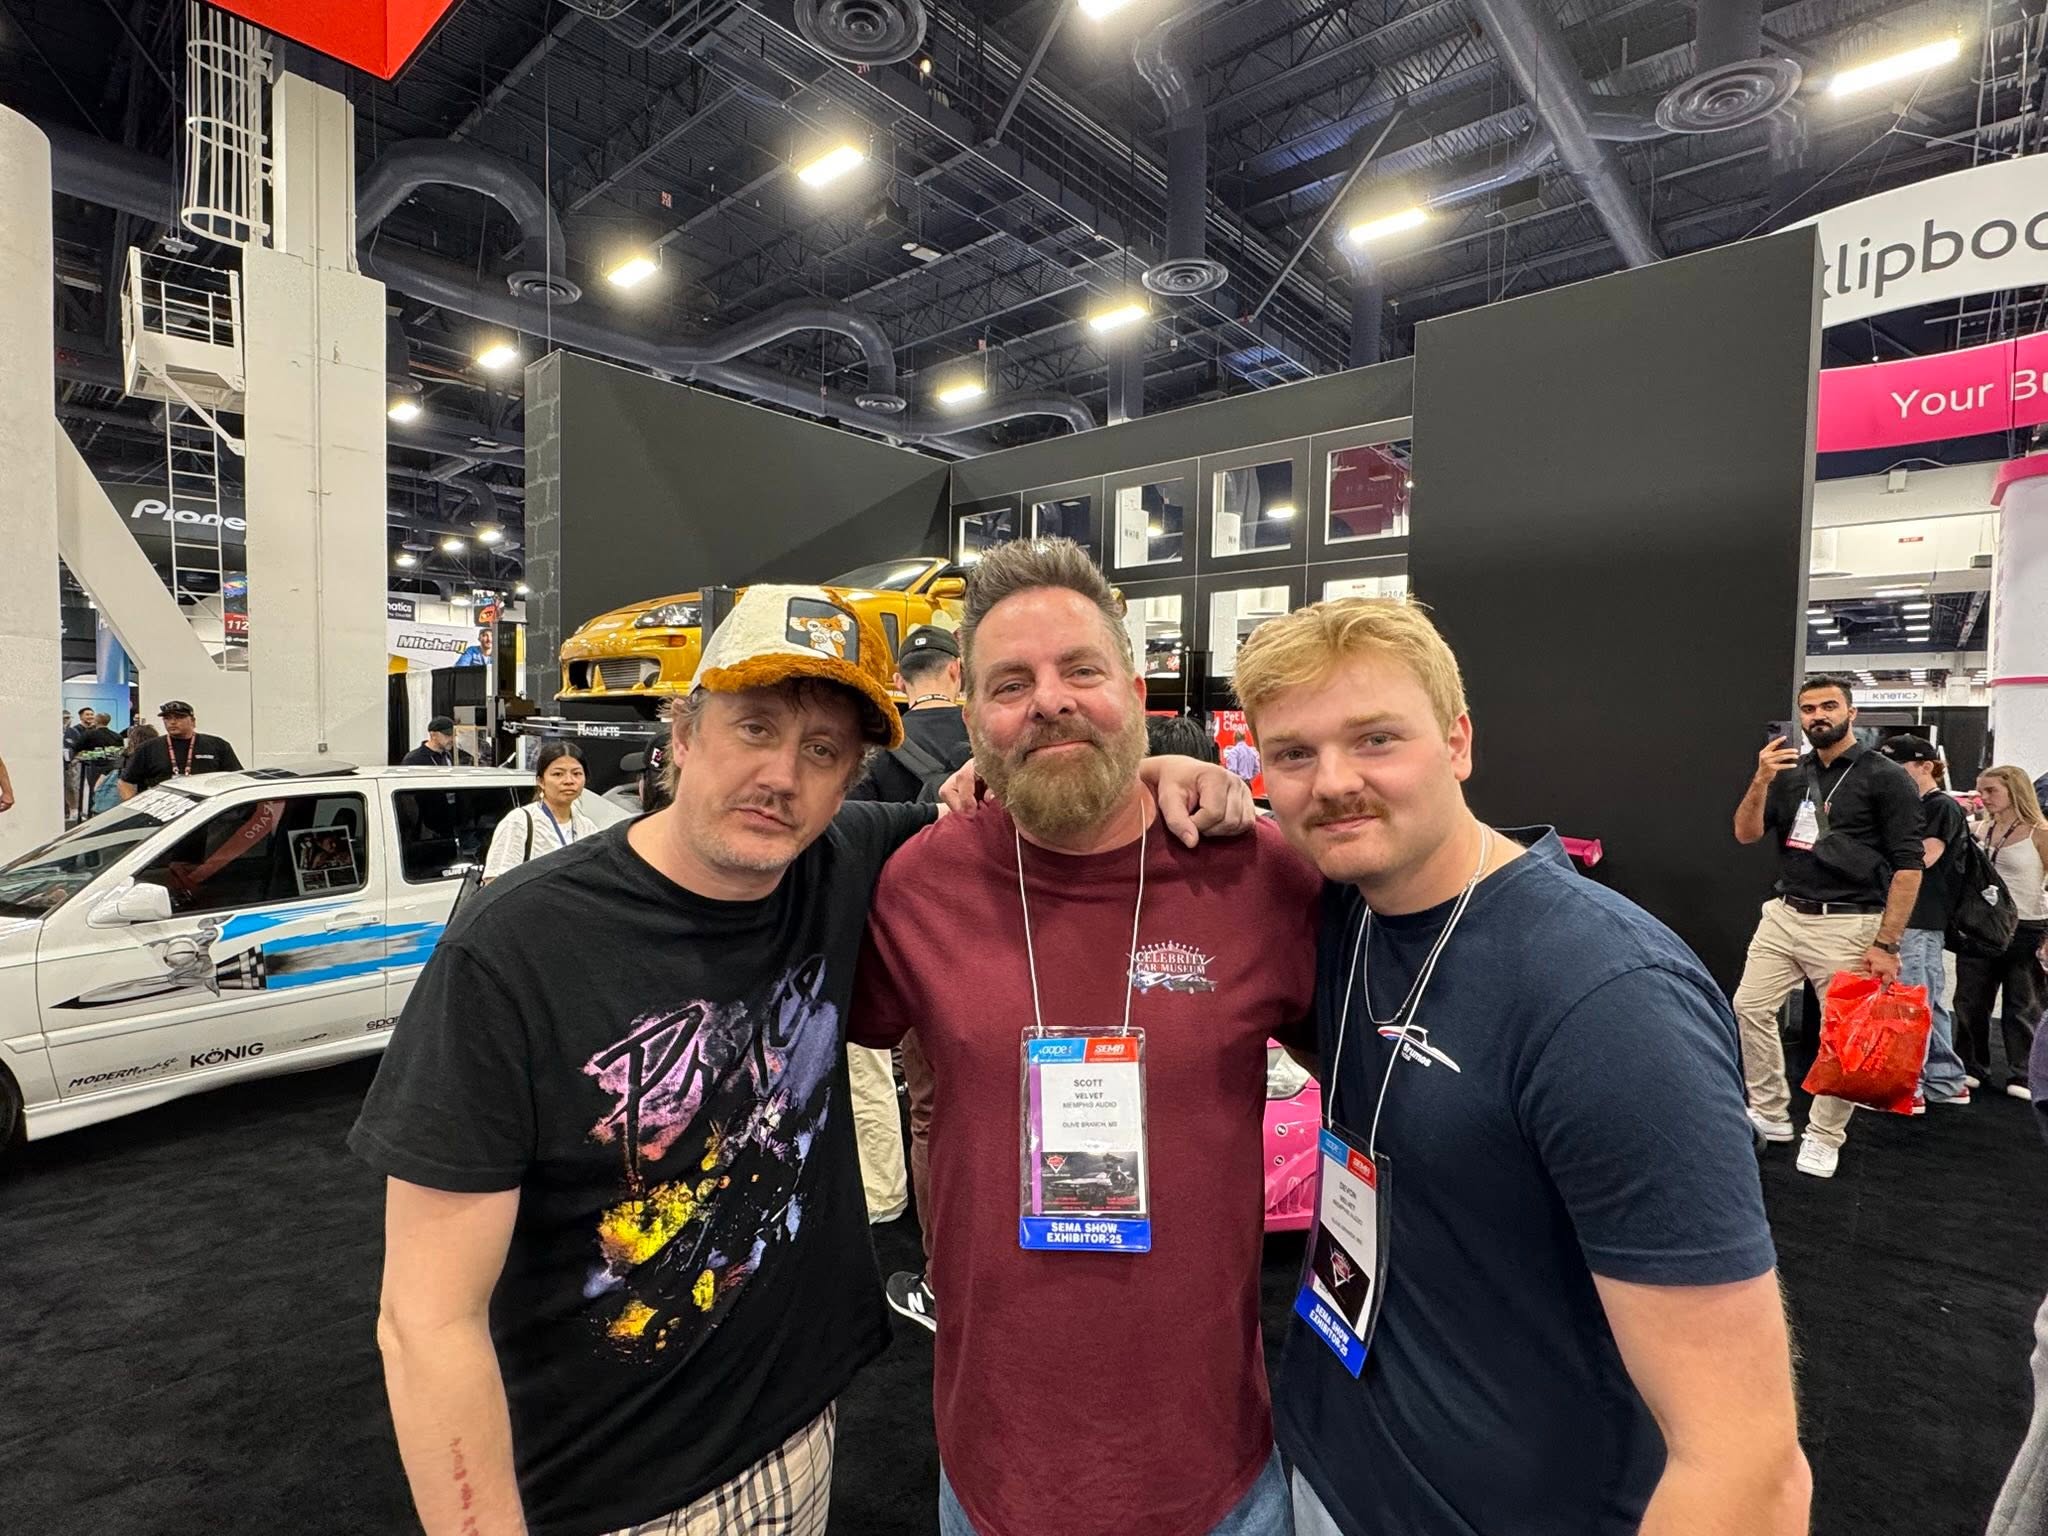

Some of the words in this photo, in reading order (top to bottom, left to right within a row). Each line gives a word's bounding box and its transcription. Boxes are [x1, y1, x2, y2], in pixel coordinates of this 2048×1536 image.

[1822, 211, 2048, 299] lipbo
[1891, 383, 1994, 419] Your
[2010, 368, 2048, 401] B
[1135, 951, 1206, 966] CELEBRITY
[1136, 963, 1157, 972] CAR
[1160, 963, 1205, 975] MUSEUM
[190, 1042, 265, 1069] KÖNIG
[1073, 1079, 1103, 1088] SCOTT
[1074, 1092, 1104, 1100] VELVET
[1051, 1222, 1082, 1233] SEMA
[1084, 1222, 1118, 1234] SHOW
[1046, 1233, 1123, 1245] EXHIBITOR-25
